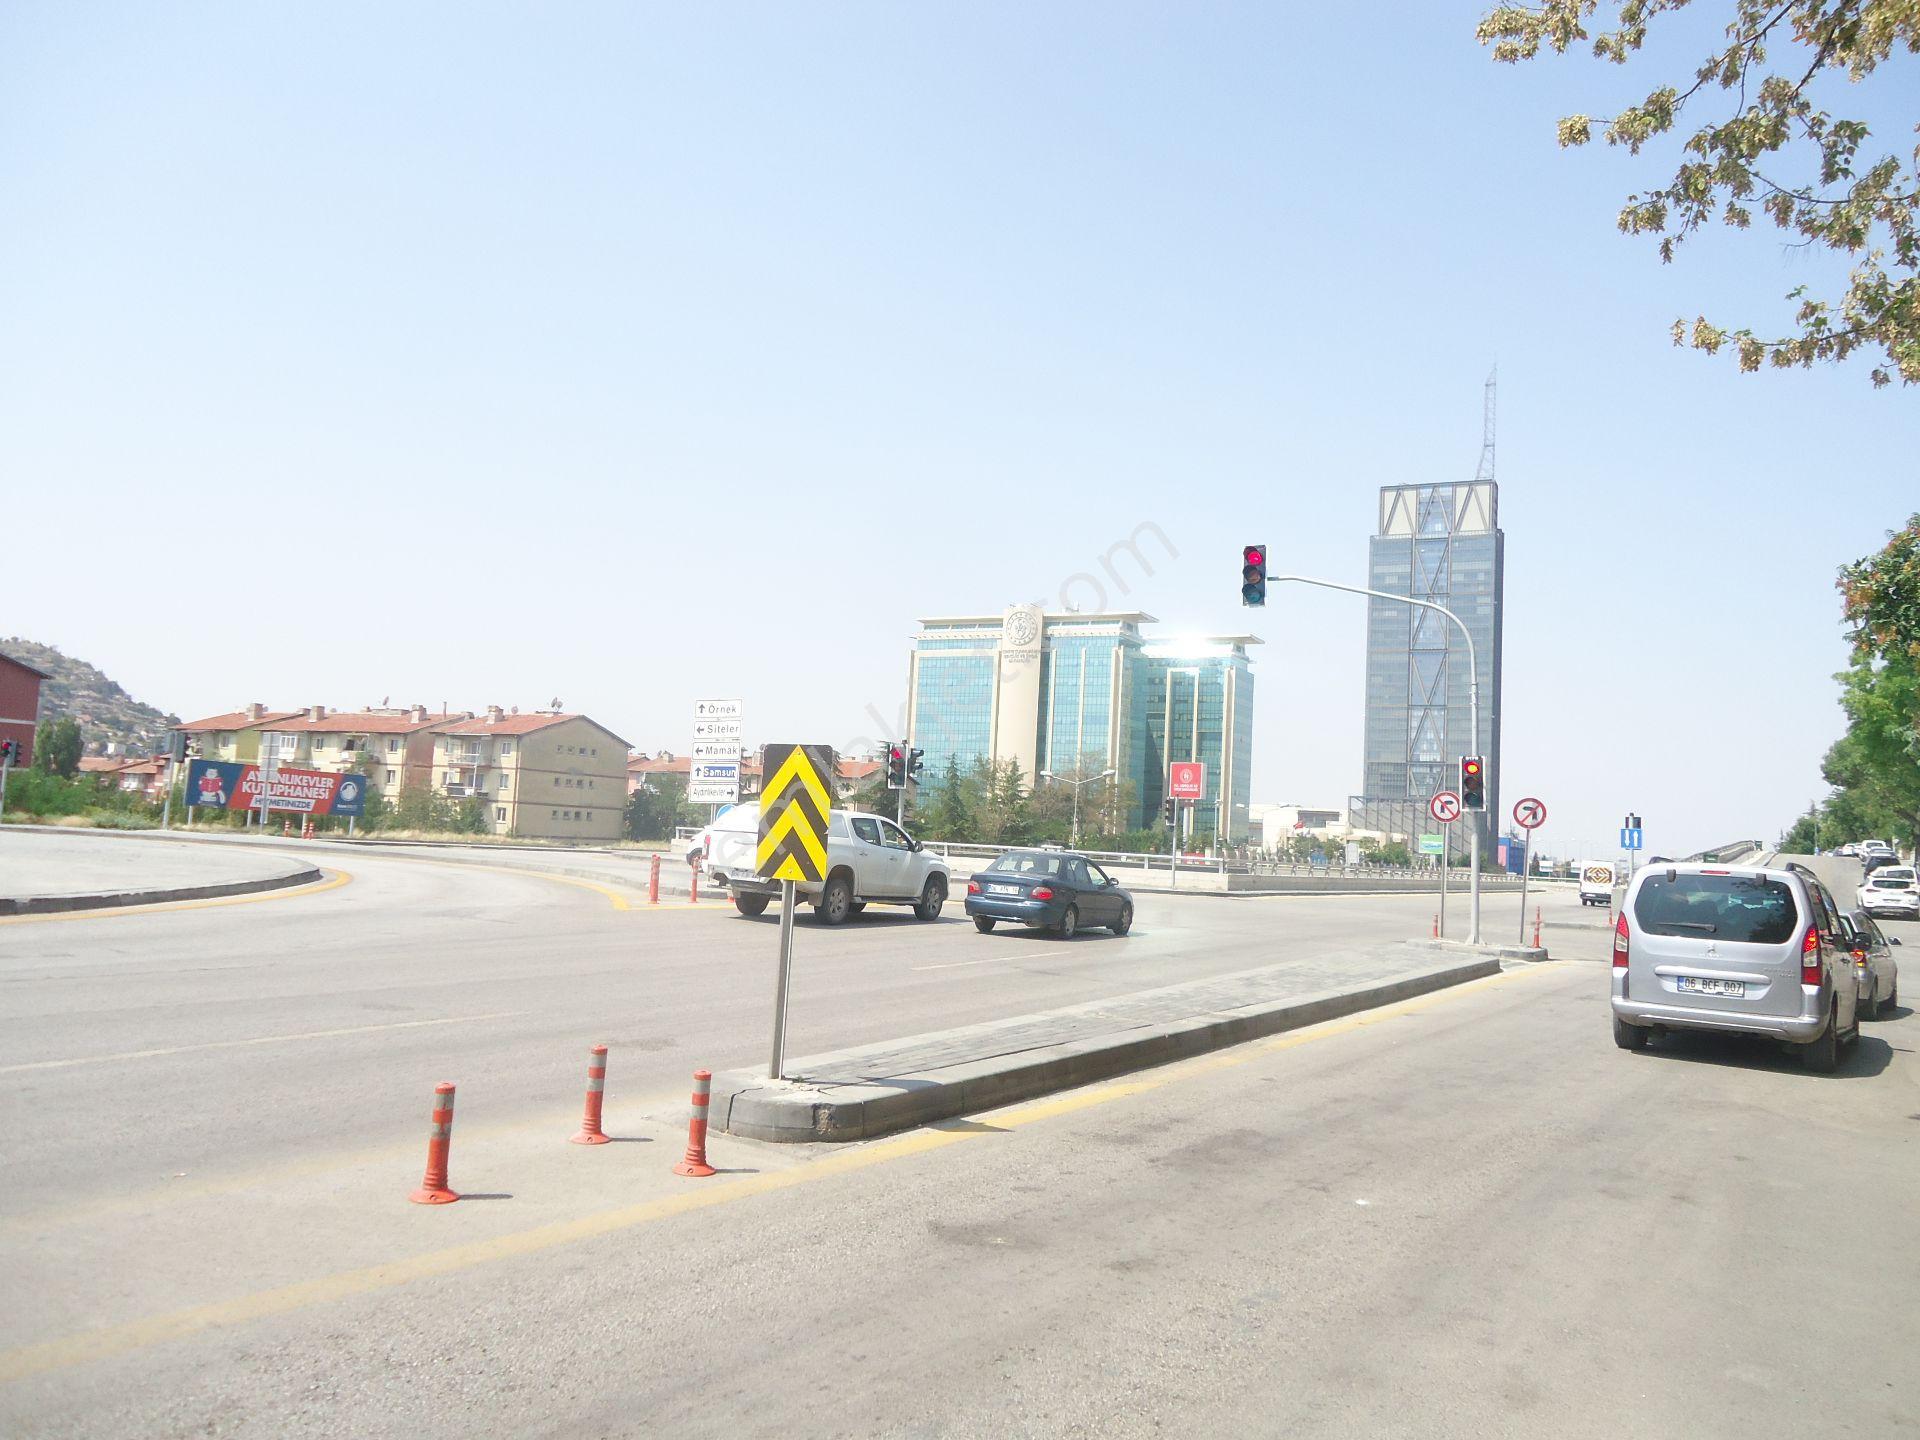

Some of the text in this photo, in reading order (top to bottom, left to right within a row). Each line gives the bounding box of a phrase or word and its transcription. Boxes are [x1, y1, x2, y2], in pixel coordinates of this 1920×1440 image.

[708, 704, 737, 714] Örnek
[707, 724, 739, 734] Siteler
[705, 746, 738, 755] Mamak
[703, 767, 736, 777] Samsun
[1684, 978, 1742, 993] 06 BCF 007
